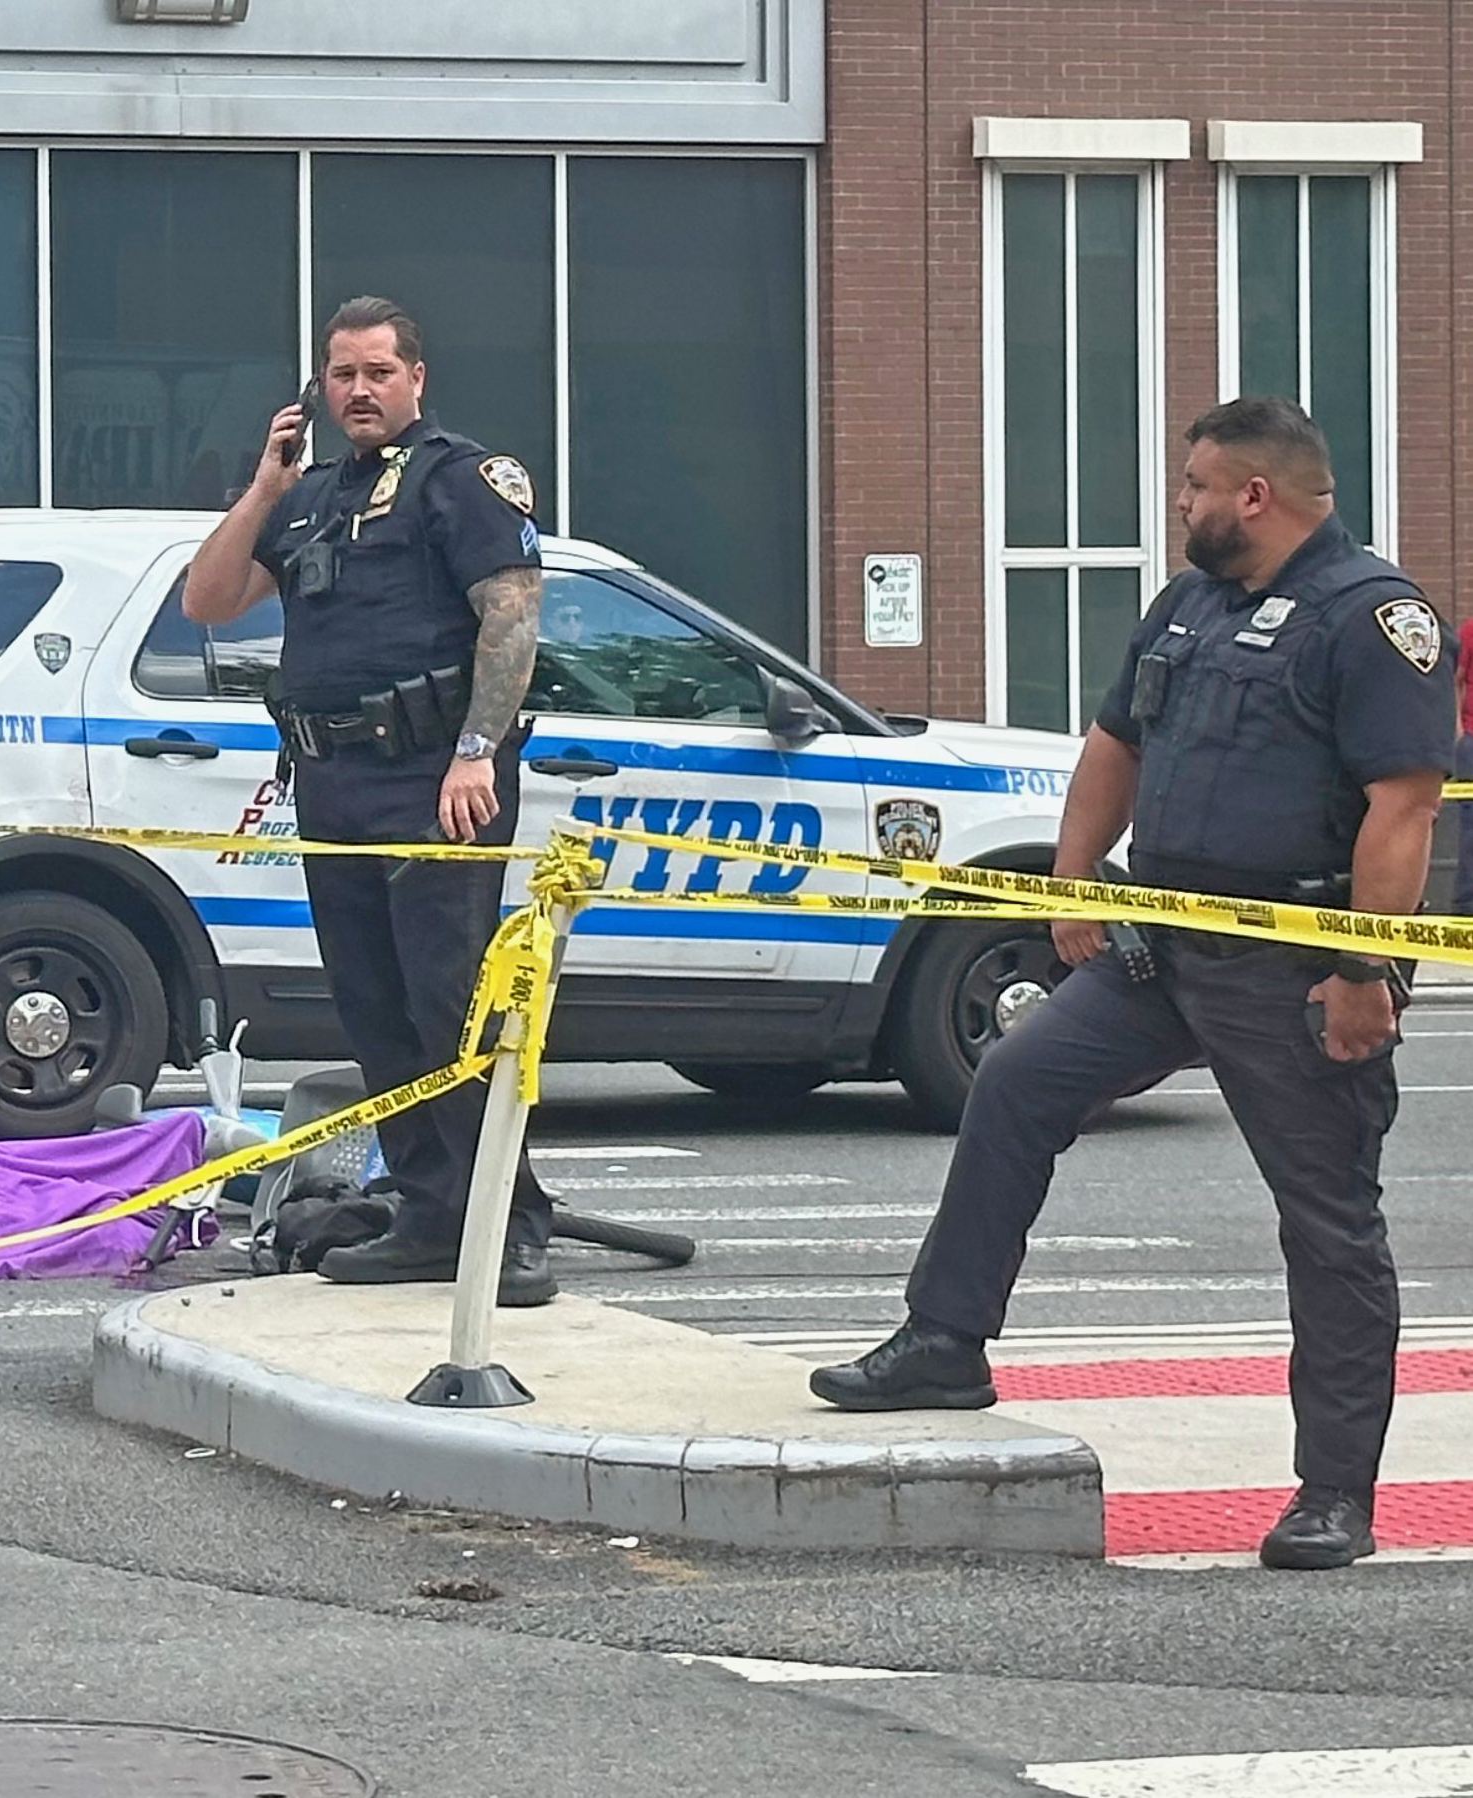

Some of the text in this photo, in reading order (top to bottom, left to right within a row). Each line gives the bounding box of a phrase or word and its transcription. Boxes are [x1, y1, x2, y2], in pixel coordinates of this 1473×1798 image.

[1010, 771, 1071, 796] POL
[569, 796, 822, 892] NYPD
[1316, 911, 1353, 933] CROSS
[418, 1066, 458, 1095] CROSS
